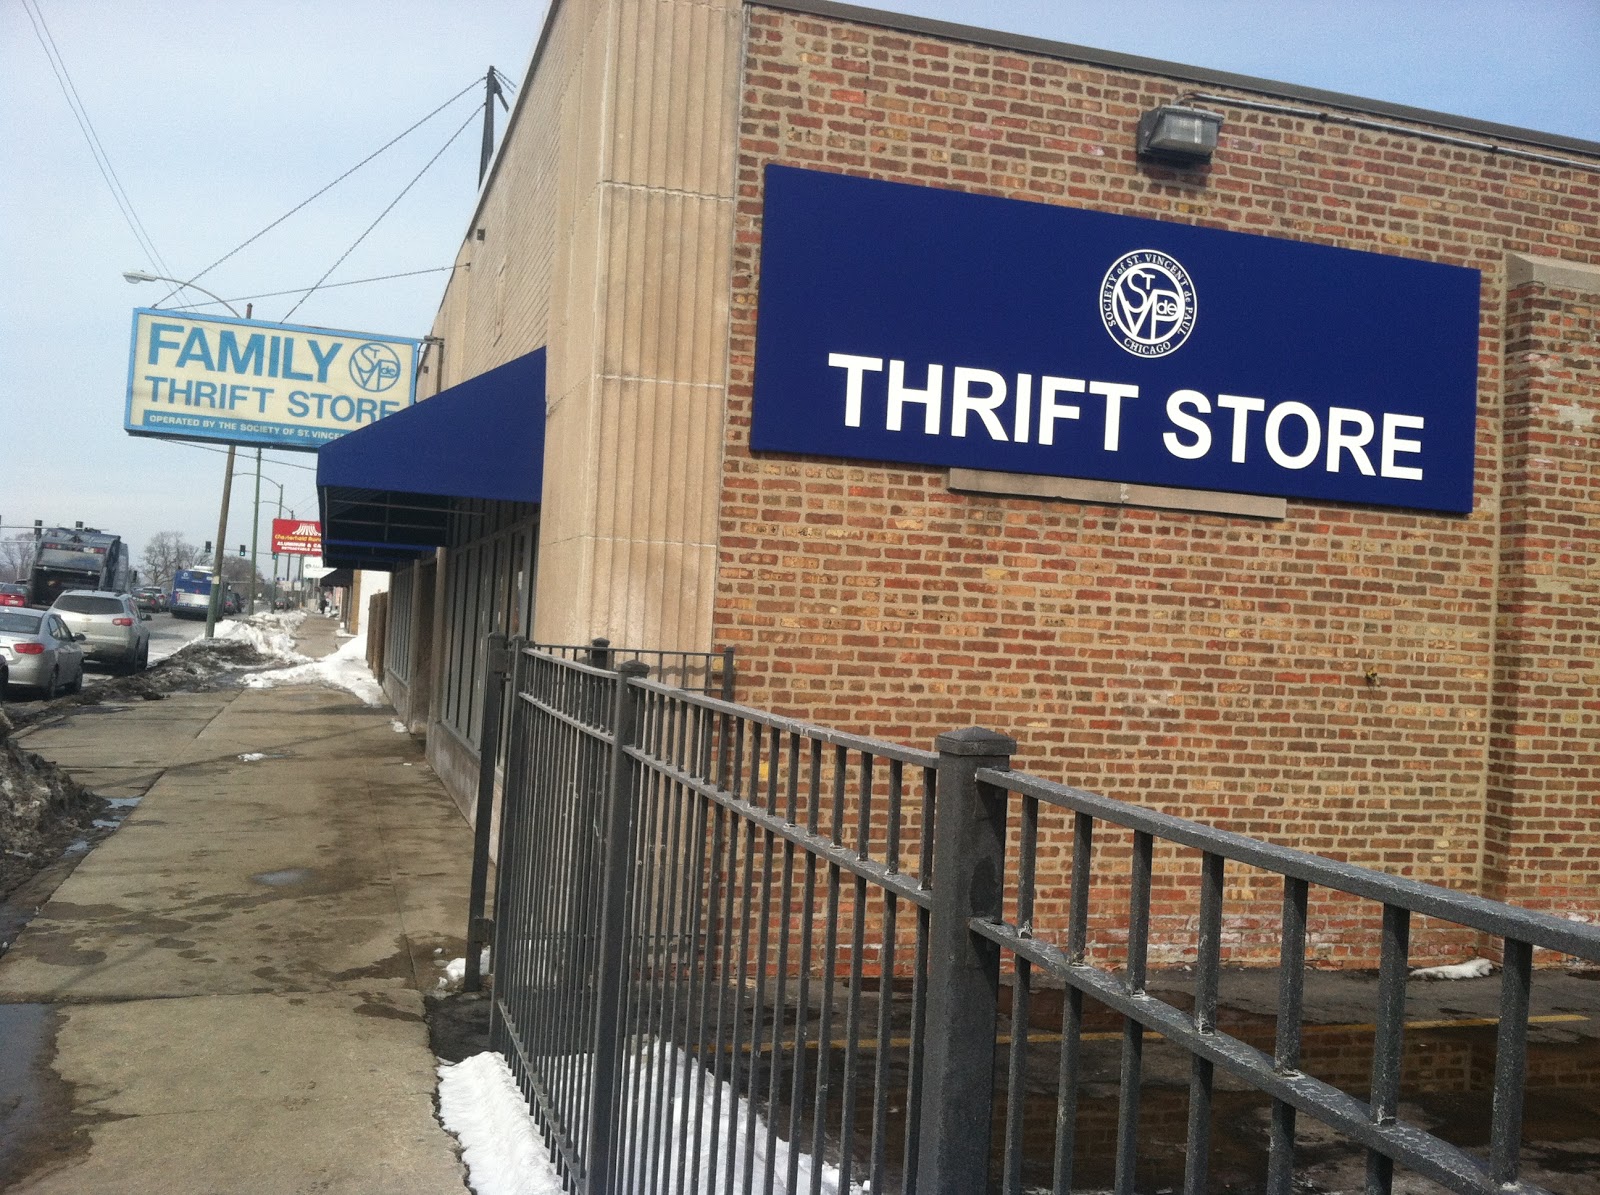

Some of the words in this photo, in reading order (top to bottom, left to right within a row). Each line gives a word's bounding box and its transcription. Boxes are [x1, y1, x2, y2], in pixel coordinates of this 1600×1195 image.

[1103, 274, 1117, 327] SOCIETY
[1145, 254, 1188, 286] VINCENT
[1178, 307, 1193, 335] PAUL
[148, 322, 343, 383] FAMILY
[1124, 338, 1171, 355] CHICAGO
[145, 376, 274, 413] THRIFT
[828, 353, 1139, 452] THRIFT
[1162, 389, 1425, 481] STORE
[149, 415, 200, 426] OPERATED
[203, 420, 215, 428] BY
[219, 421, 237, 430] THE
[240, 423, 280, 434] SOCIETY
[282, 428, 295, 436] OF
[311, 431, 344, 440] VINCE
